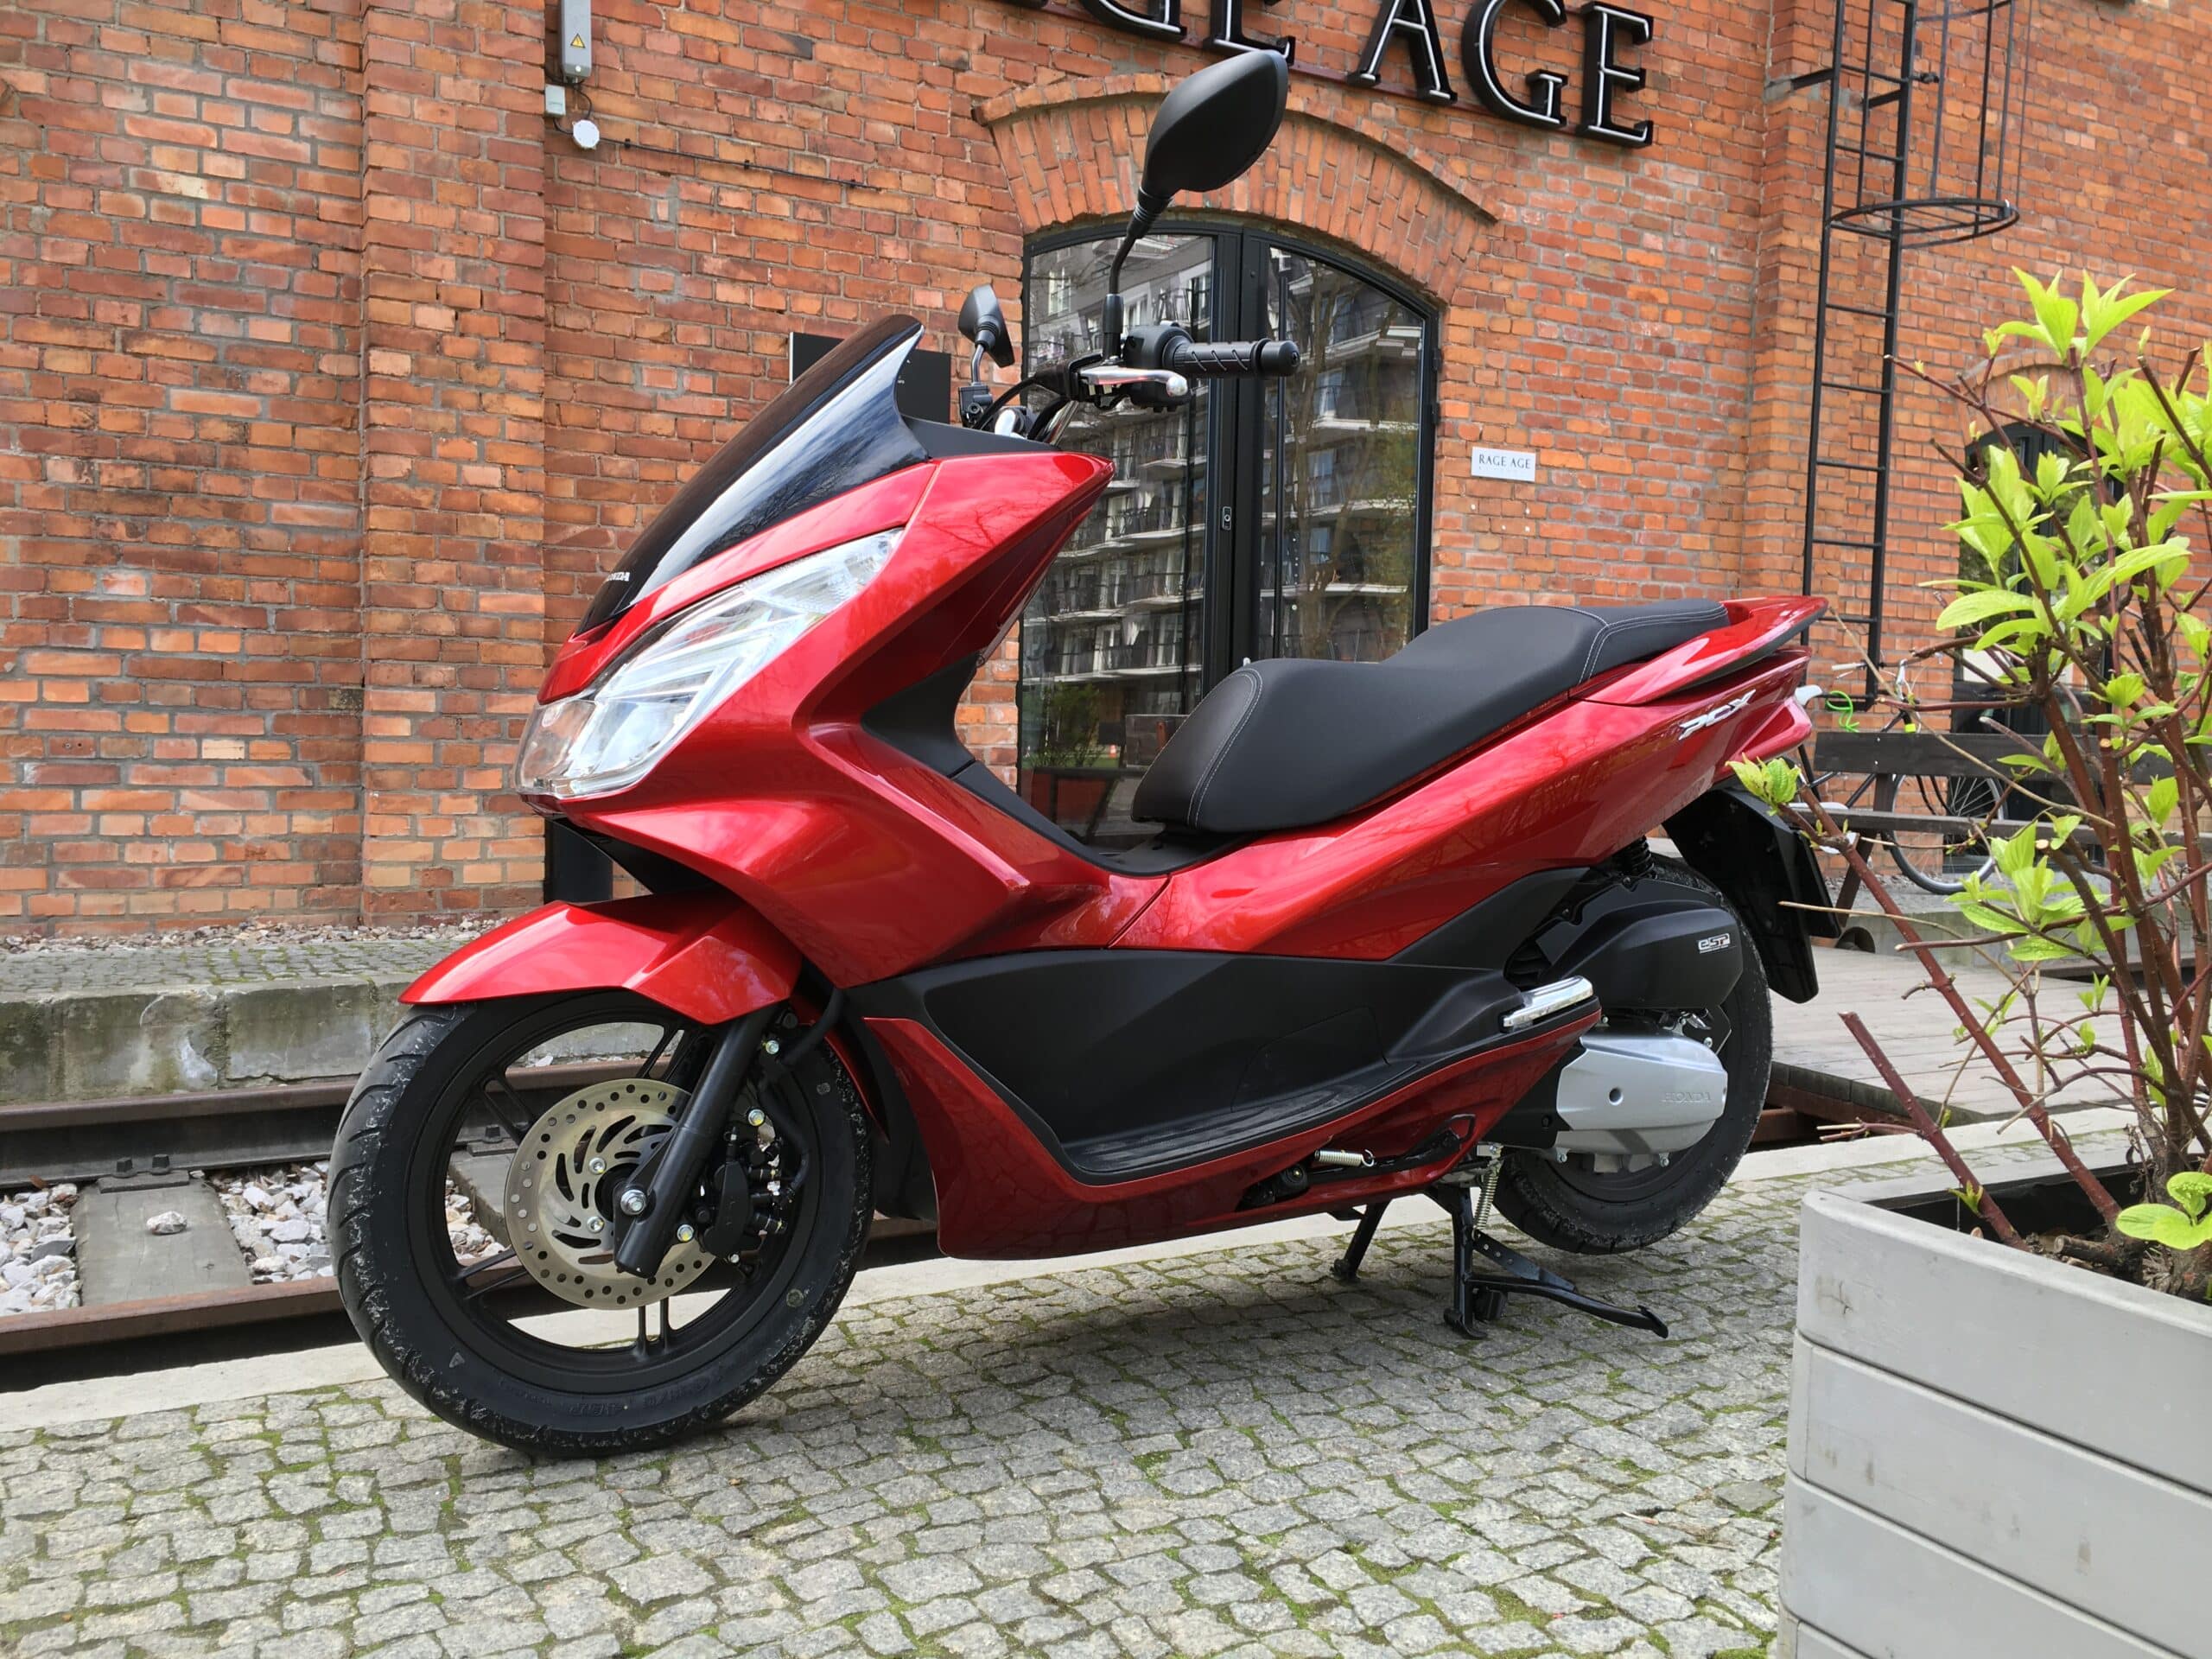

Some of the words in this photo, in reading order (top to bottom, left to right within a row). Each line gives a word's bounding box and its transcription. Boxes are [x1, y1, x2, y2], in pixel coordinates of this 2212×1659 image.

[1346, 0, 1654, 149] AGE
[1478, 453, 1507, 467] RAGE
[1510, 457, 1532, 470] AGE
